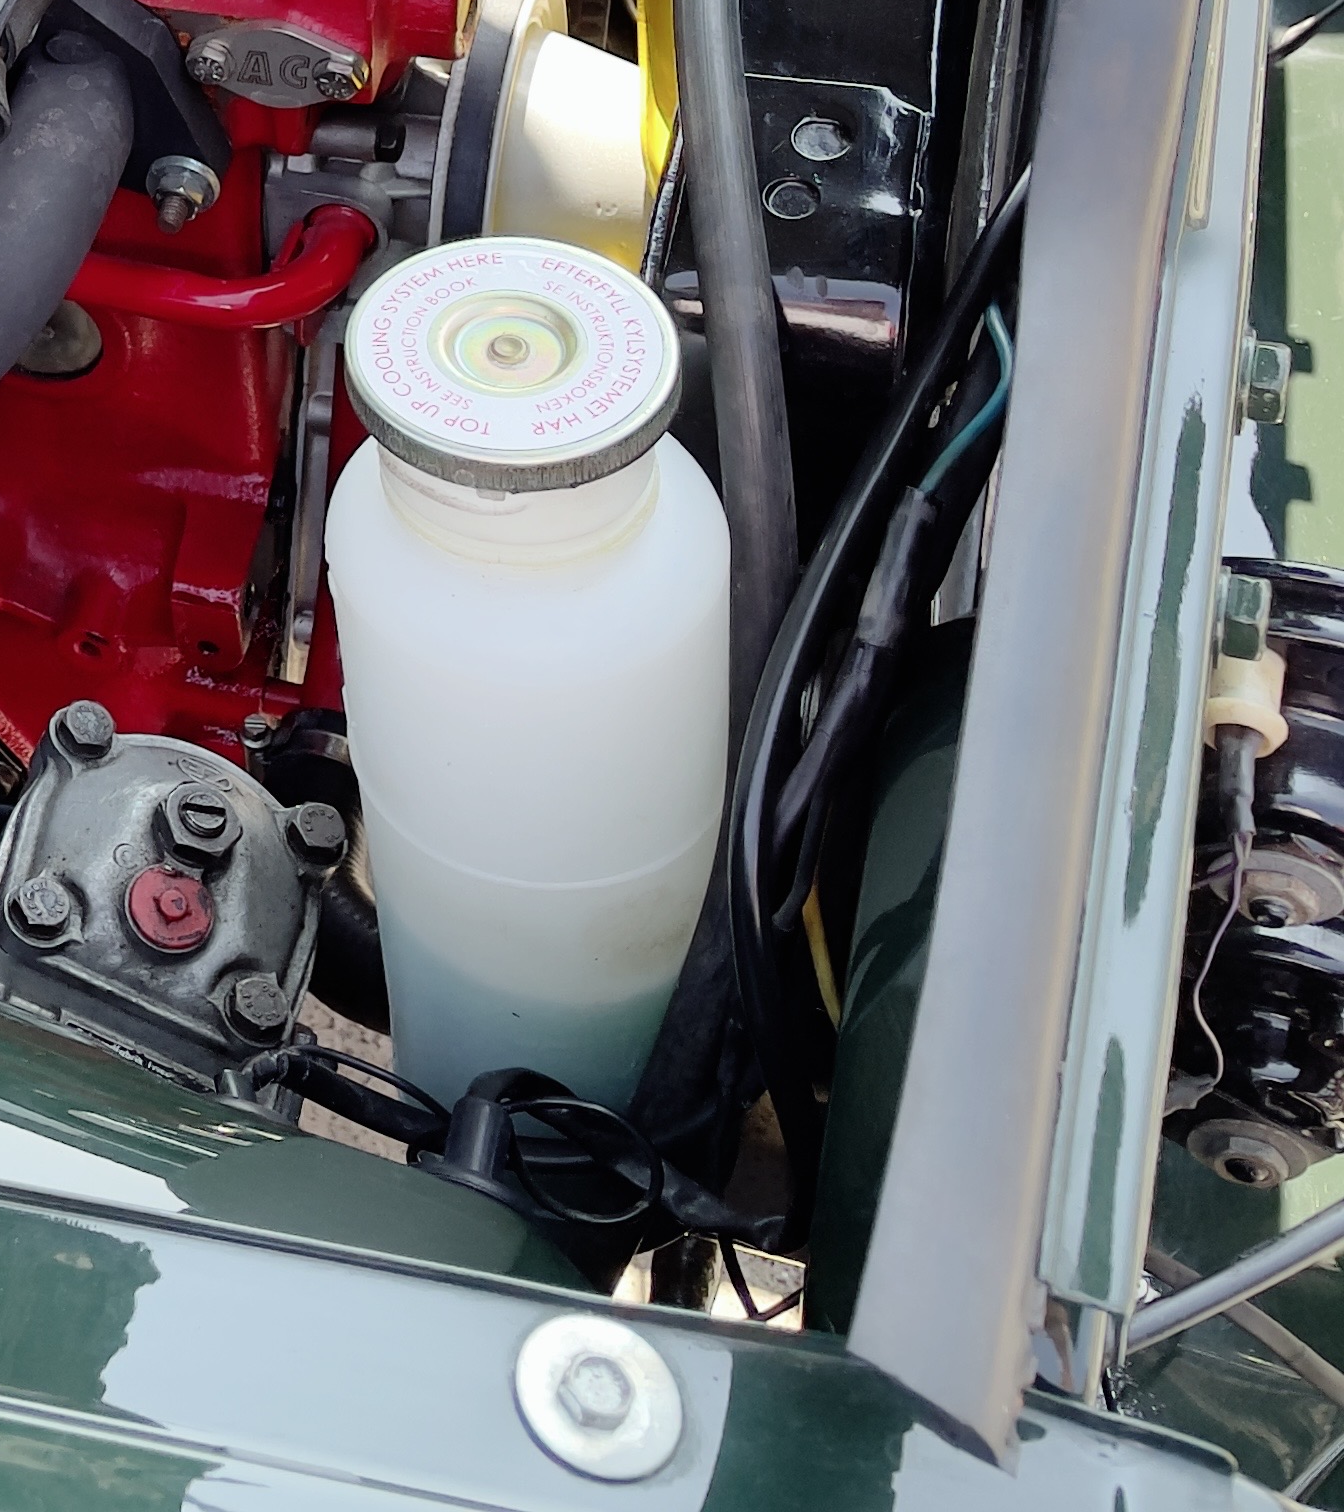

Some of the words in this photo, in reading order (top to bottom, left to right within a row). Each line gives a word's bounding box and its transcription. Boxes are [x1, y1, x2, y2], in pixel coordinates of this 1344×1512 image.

[237, 49, 310, 90] AC
[447, 252, 504, 270] HERE
[381, 268, 441, 315] SYSTEM
[426, 277, 477, 306] BOOK
[540, 257, 630, 316] EFTERFYLL
[543, 280, 563, 294] SE
[373, 316, 412, 397] COOLING
[401, 305, 439, 392] INSTRUCTION
[535, 291, 613, 412] INSTRUKTIONSBOKEN
[586, 316, 645, 418] KYLSYSTEMET
[411, 400, 439, 418] UP
[440, 390, 474, 410] SEE
[444, 416, 491, 436] TOP
[532, 413, 584, 436] HÄR
